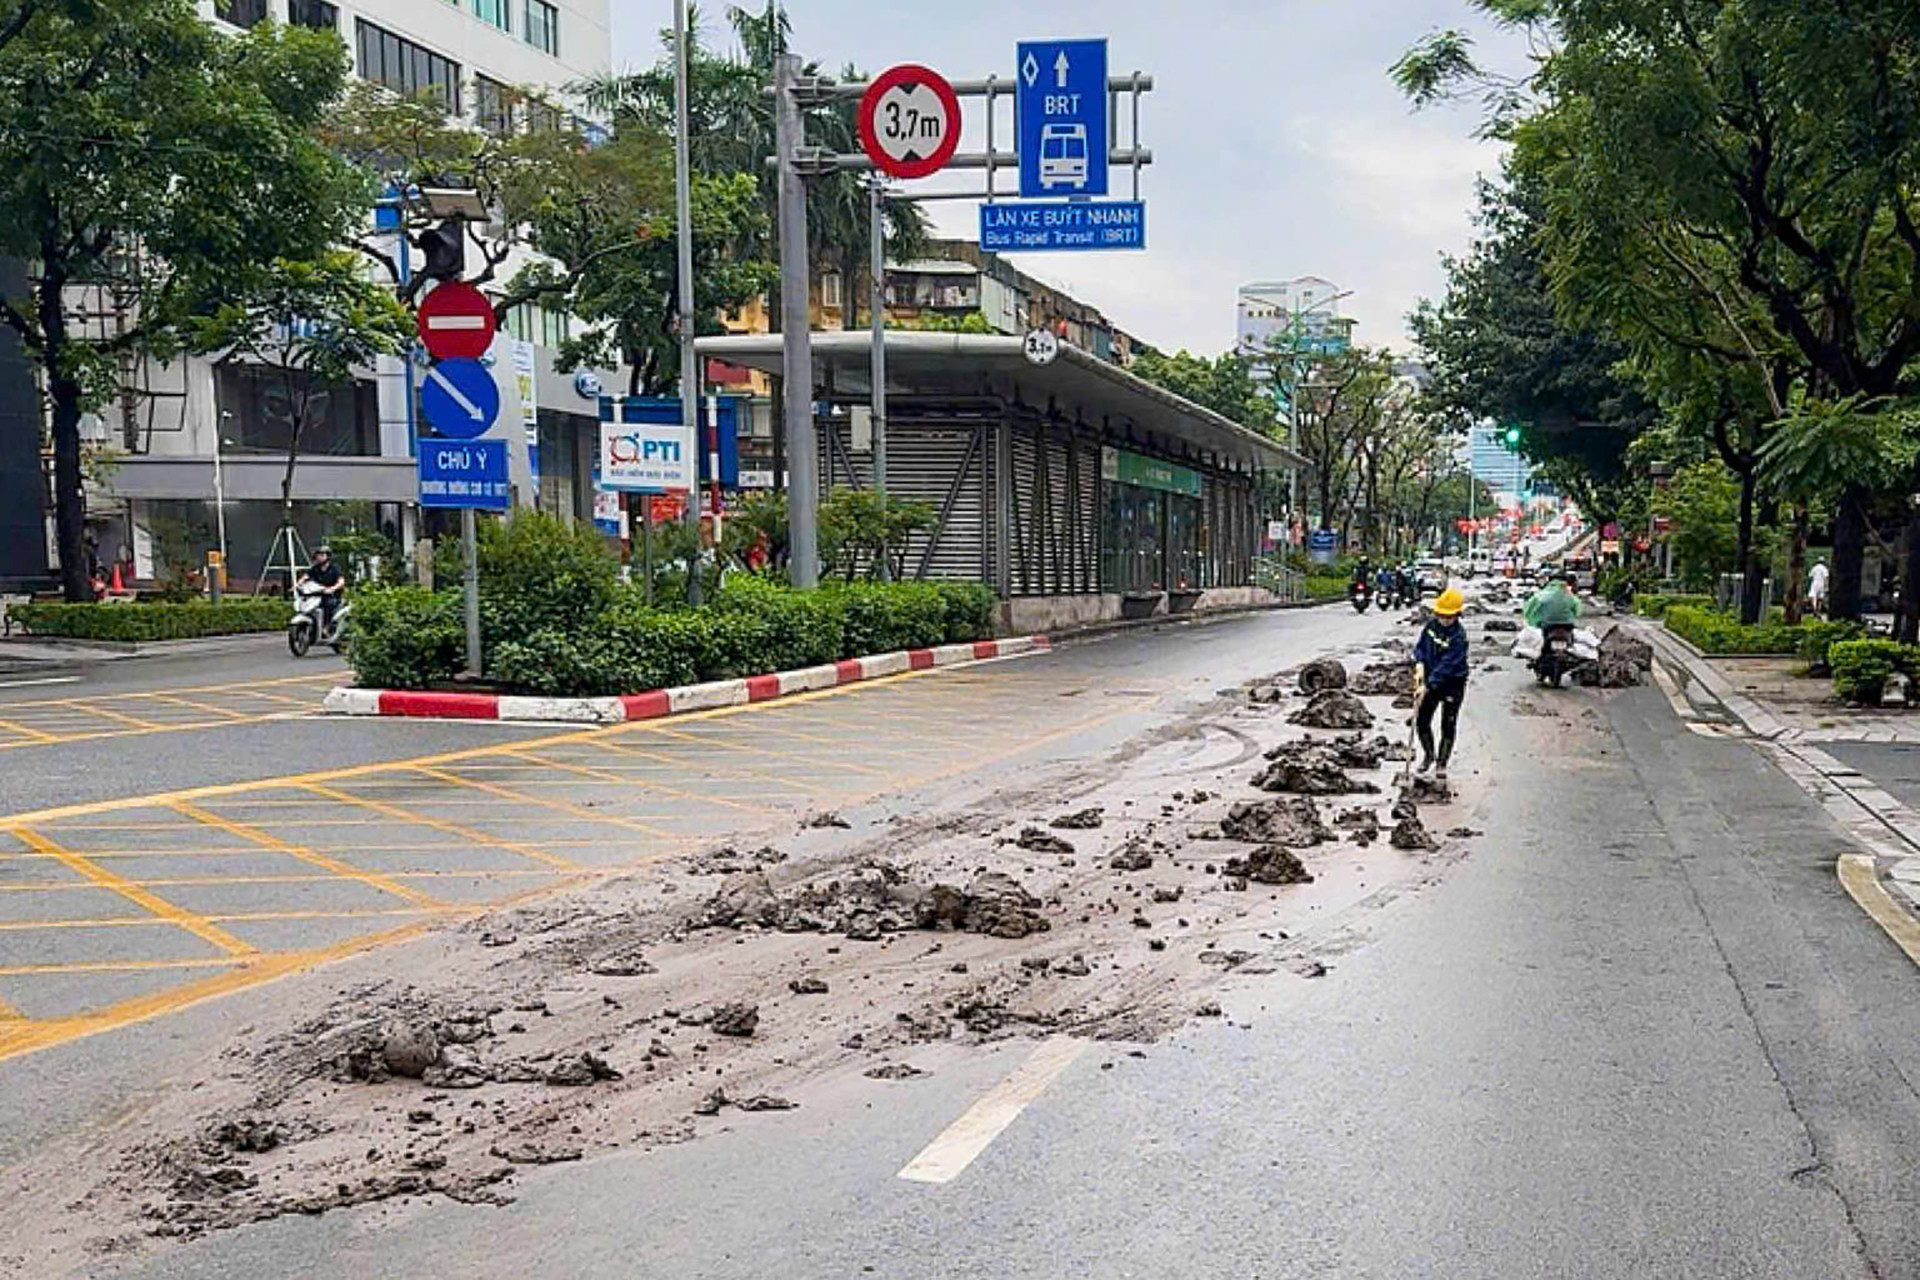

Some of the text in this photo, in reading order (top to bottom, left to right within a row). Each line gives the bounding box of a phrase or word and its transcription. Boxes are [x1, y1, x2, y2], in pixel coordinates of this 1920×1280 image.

[1044, 94, 1081, 115] BRT
[886, 101, 940, 140] 3,7m
[985, 206, 1139, 227] LÀN XE BUÝT NHANH
[986, 227, 1138, 246] Bus Rapid Transit (BRT)
[438, 446, 487, 470] CHÚ Ý
[643, 440, 680, 462] PTI
